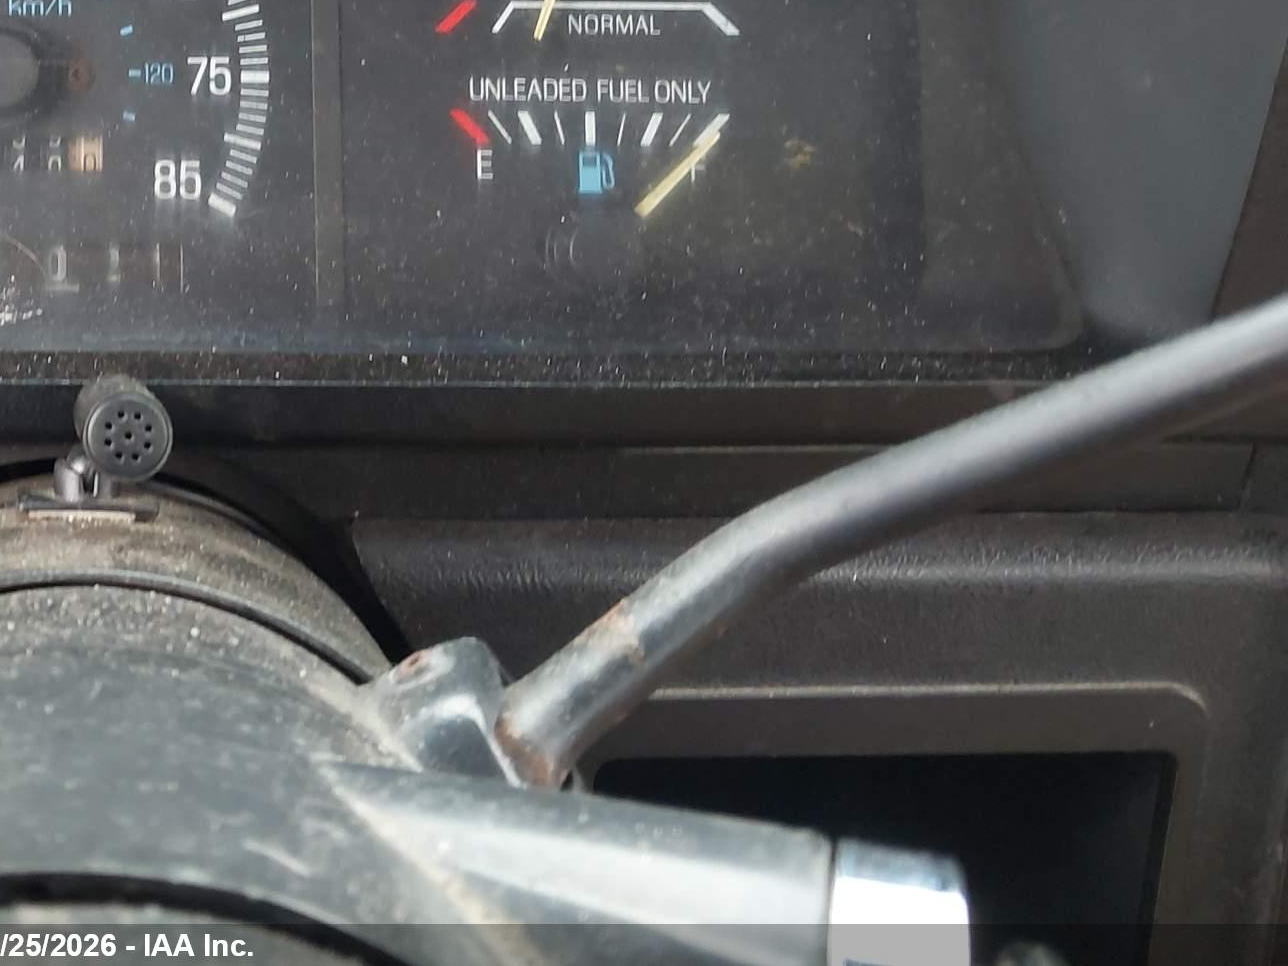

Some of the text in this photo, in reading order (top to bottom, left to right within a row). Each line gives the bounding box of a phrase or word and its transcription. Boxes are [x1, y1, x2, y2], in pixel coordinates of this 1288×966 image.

[567, 13, 661, 36] NORMAL
[144, 62, 175, 85] 120
[186, 55, 233, 96] 75
[468, 76, 711, 104] UNLEADED FUEL ONLY
[153, 159, 203, 200] 85
[476, 148, 494, 182] E
